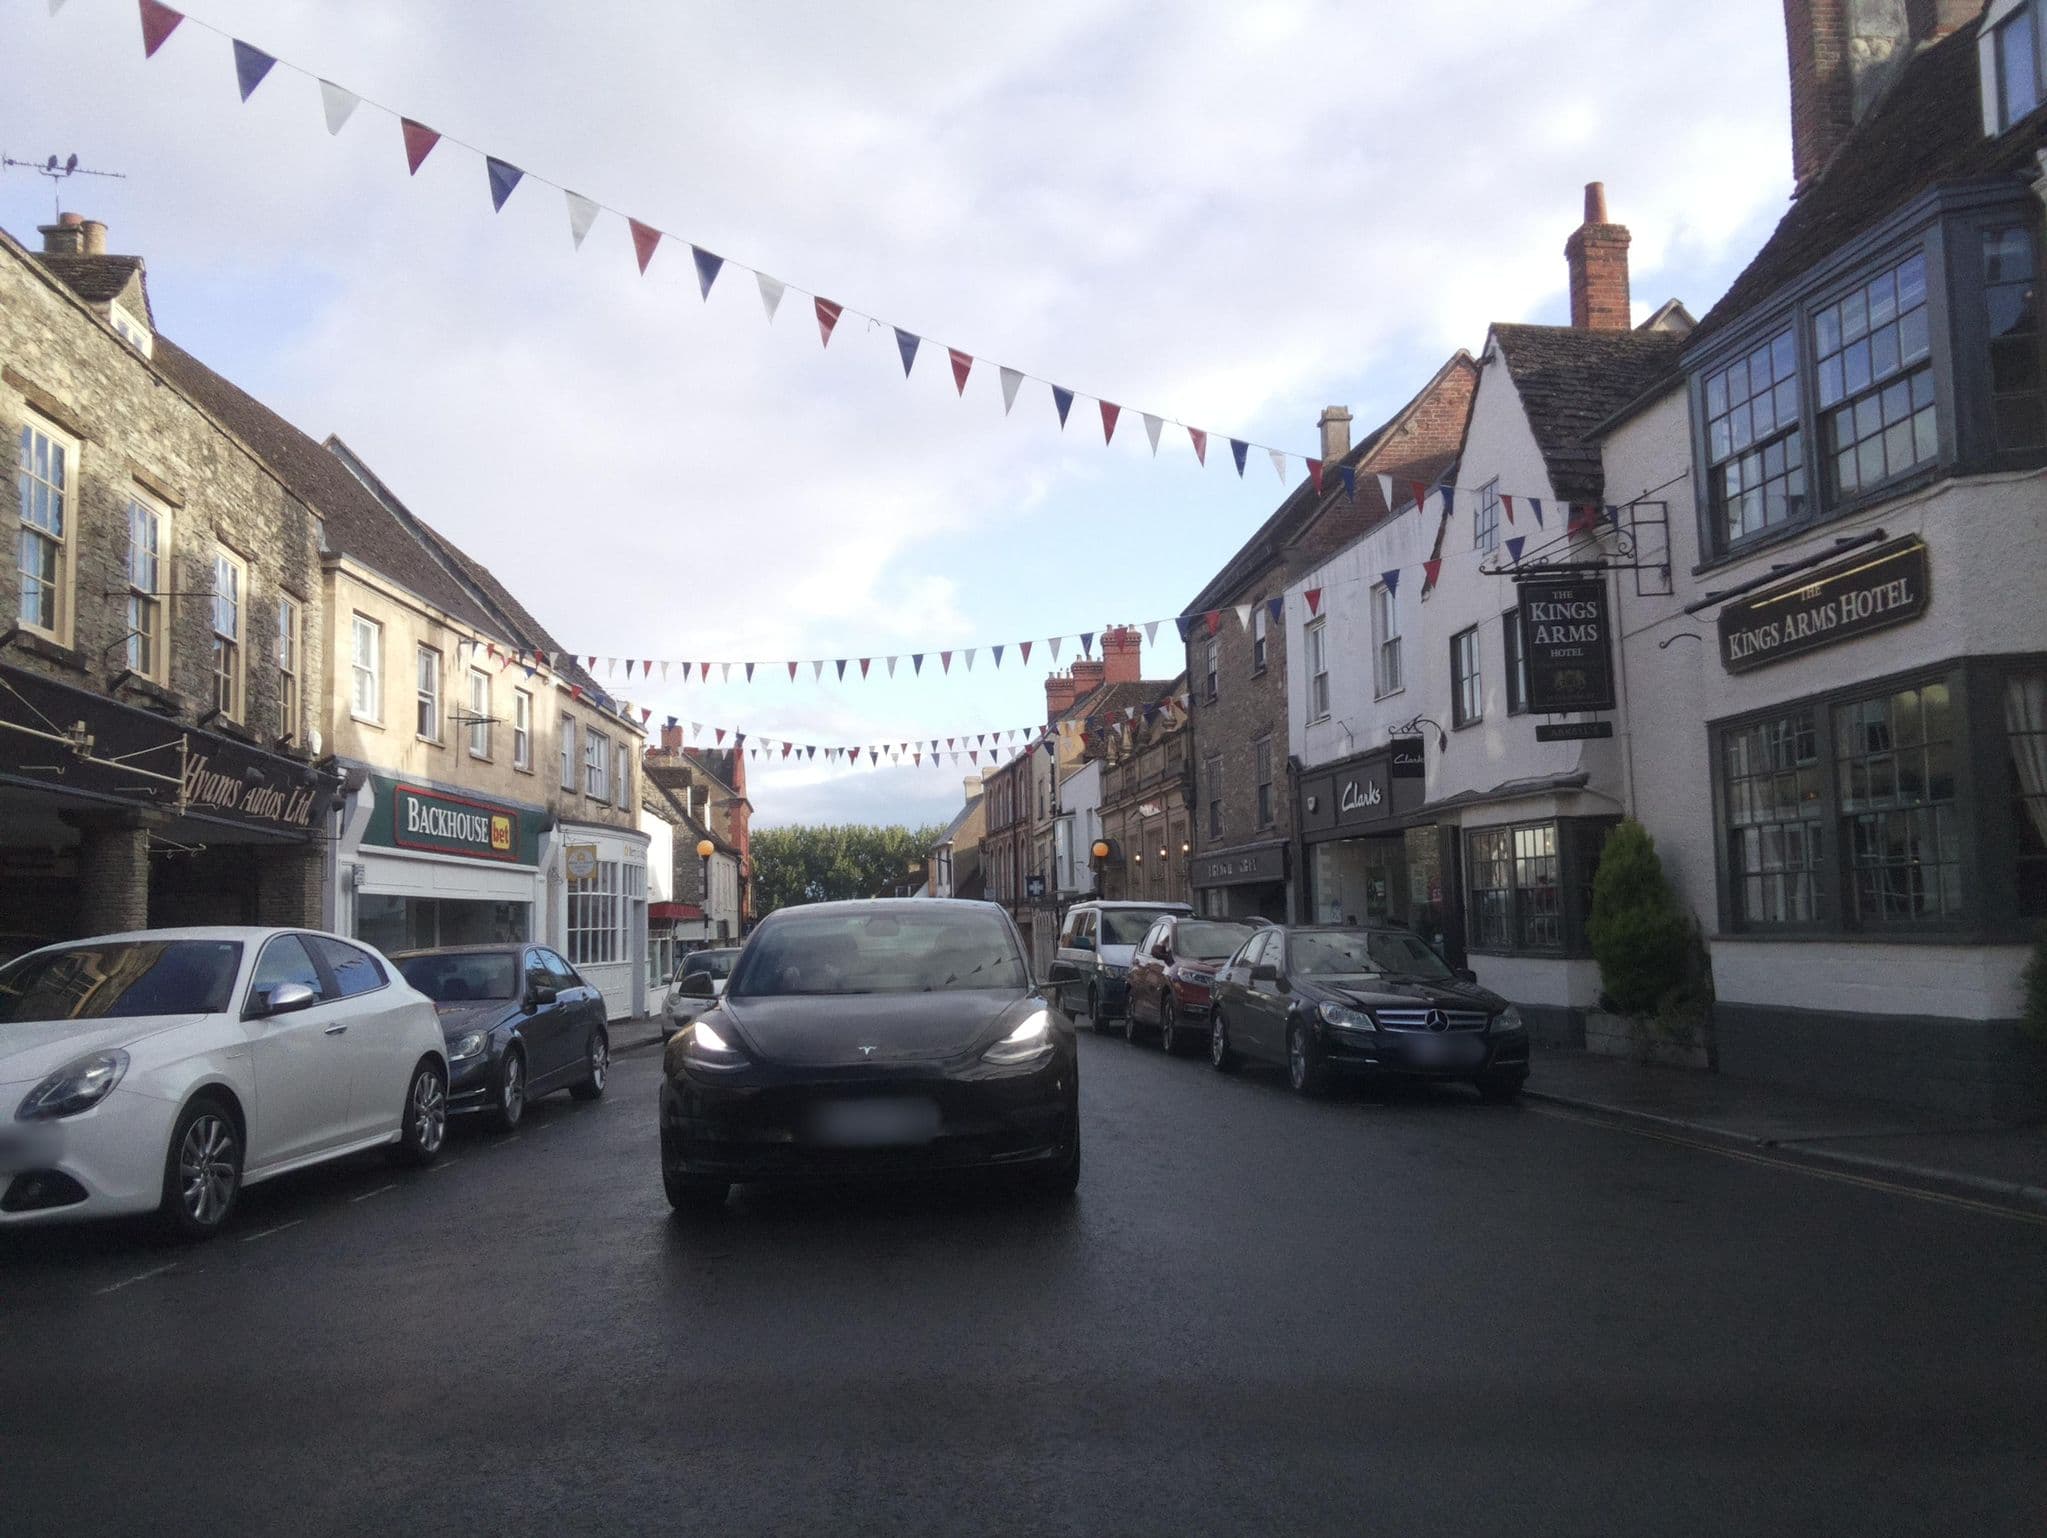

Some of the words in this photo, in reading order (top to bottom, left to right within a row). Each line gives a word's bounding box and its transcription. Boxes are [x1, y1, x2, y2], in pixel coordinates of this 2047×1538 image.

[1552, 590, 1574, 600] THE
[1801, 585, 1823, 602] THE
[1530, 601, 1598, 622] KINGS
[1728, 622, 1780, 661] KINGS
[1783, 602, 1838, 644] ARMS
[1840, 577, 1915, 625] HOTEL
[1534, 624, 1599, 645] ARMS
[1551, 647, 1584, 658] HOTEL
[1393, 753, 1425, 765] Clark
[184, 753, 242, 807] Hyams
[284, 786, 316, 826] Ltd.
[1341, 780, 1381, 812] Clarks
[407, 797, 489, 843] BACKHOUSE
[493, 821, 509, 844] bet
